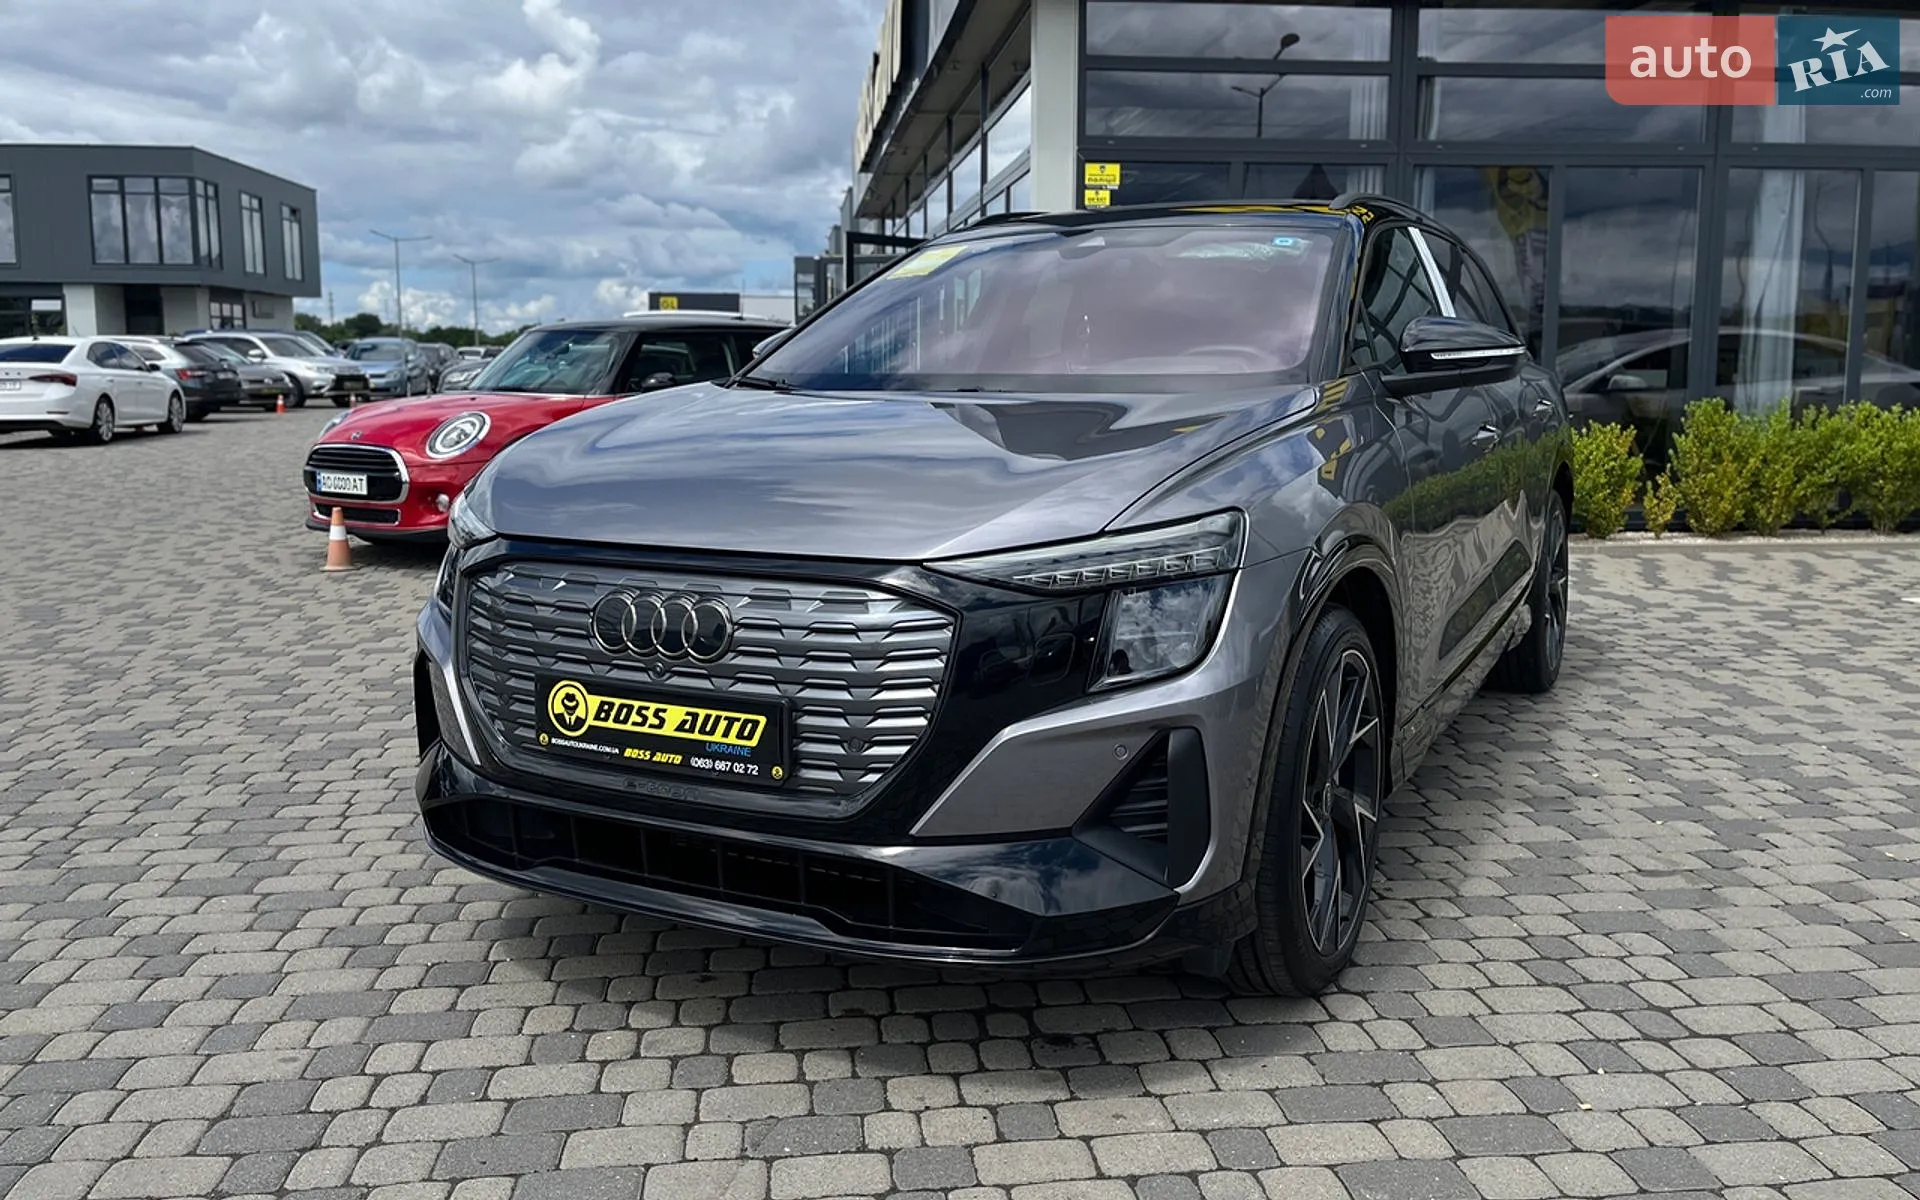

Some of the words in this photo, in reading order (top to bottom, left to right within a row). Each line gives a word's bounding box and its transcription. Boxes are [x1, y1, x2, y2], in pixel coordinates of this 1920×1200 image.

[593, 700, 667, 729] BOSS
[675, 711, 761, 740] AUTO
[623, 747, 652, 761] BOSS
[652, 751, 683, 766] AUTO
[705, 742, 752, 757] UKRAINE
[690, 755, 714, 769] (063)
[732, 762, 746, 774] 02
[746, 764, 760, 776] 72
